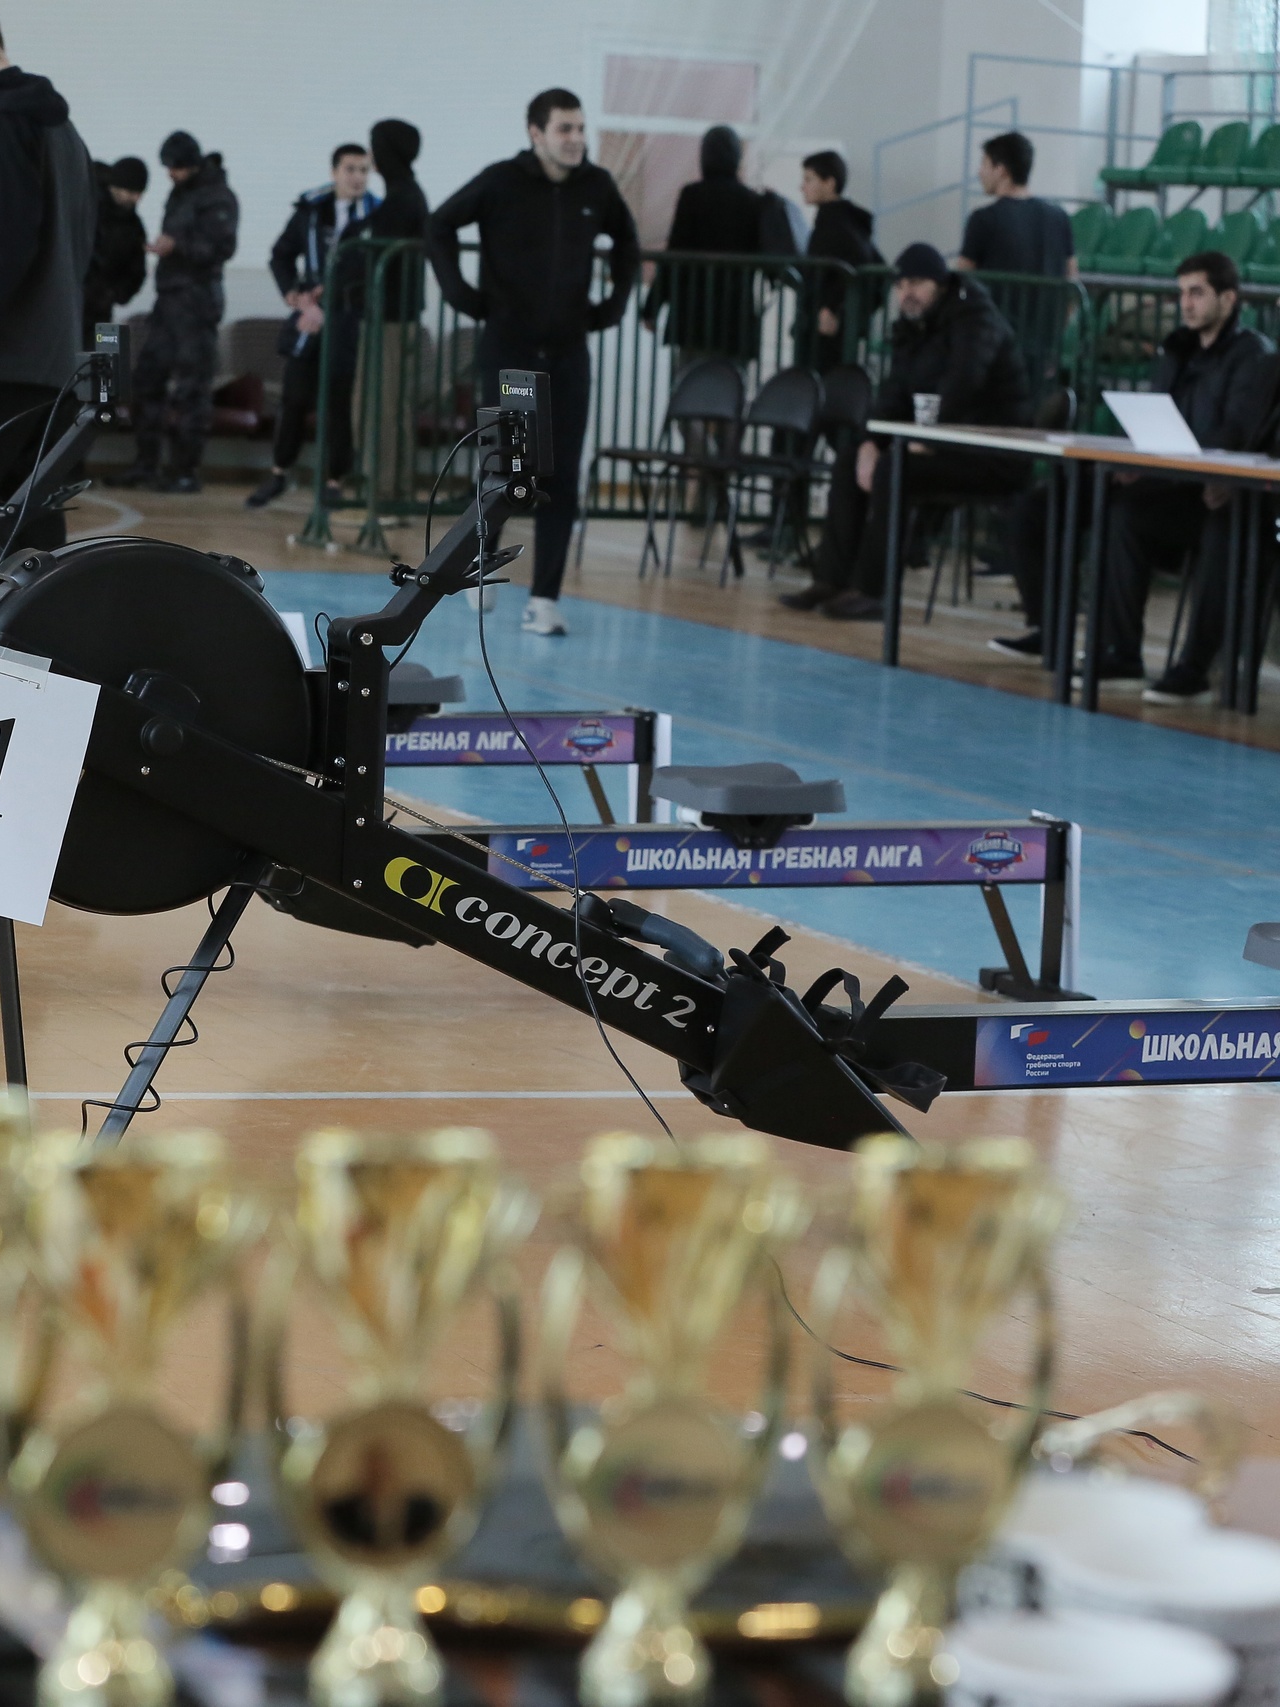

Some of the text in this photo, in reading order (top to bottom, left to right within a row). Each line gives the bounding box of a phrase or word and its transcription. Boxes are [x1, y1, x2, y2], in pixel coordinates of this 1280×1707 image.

[475, 730, 527, 751] ЛИГА
[627, 845, 923, 871] ШКОЛЬНАЯ ГРЕБНАЯ ЛИГА
[455, 896, 697, 1029] concept 2
[1026, 1053, 1065, 1061] Федерация
[1025, 1061, 1081, 1070] гребного спорта
[1025, 1069, 1050, 1077] России
